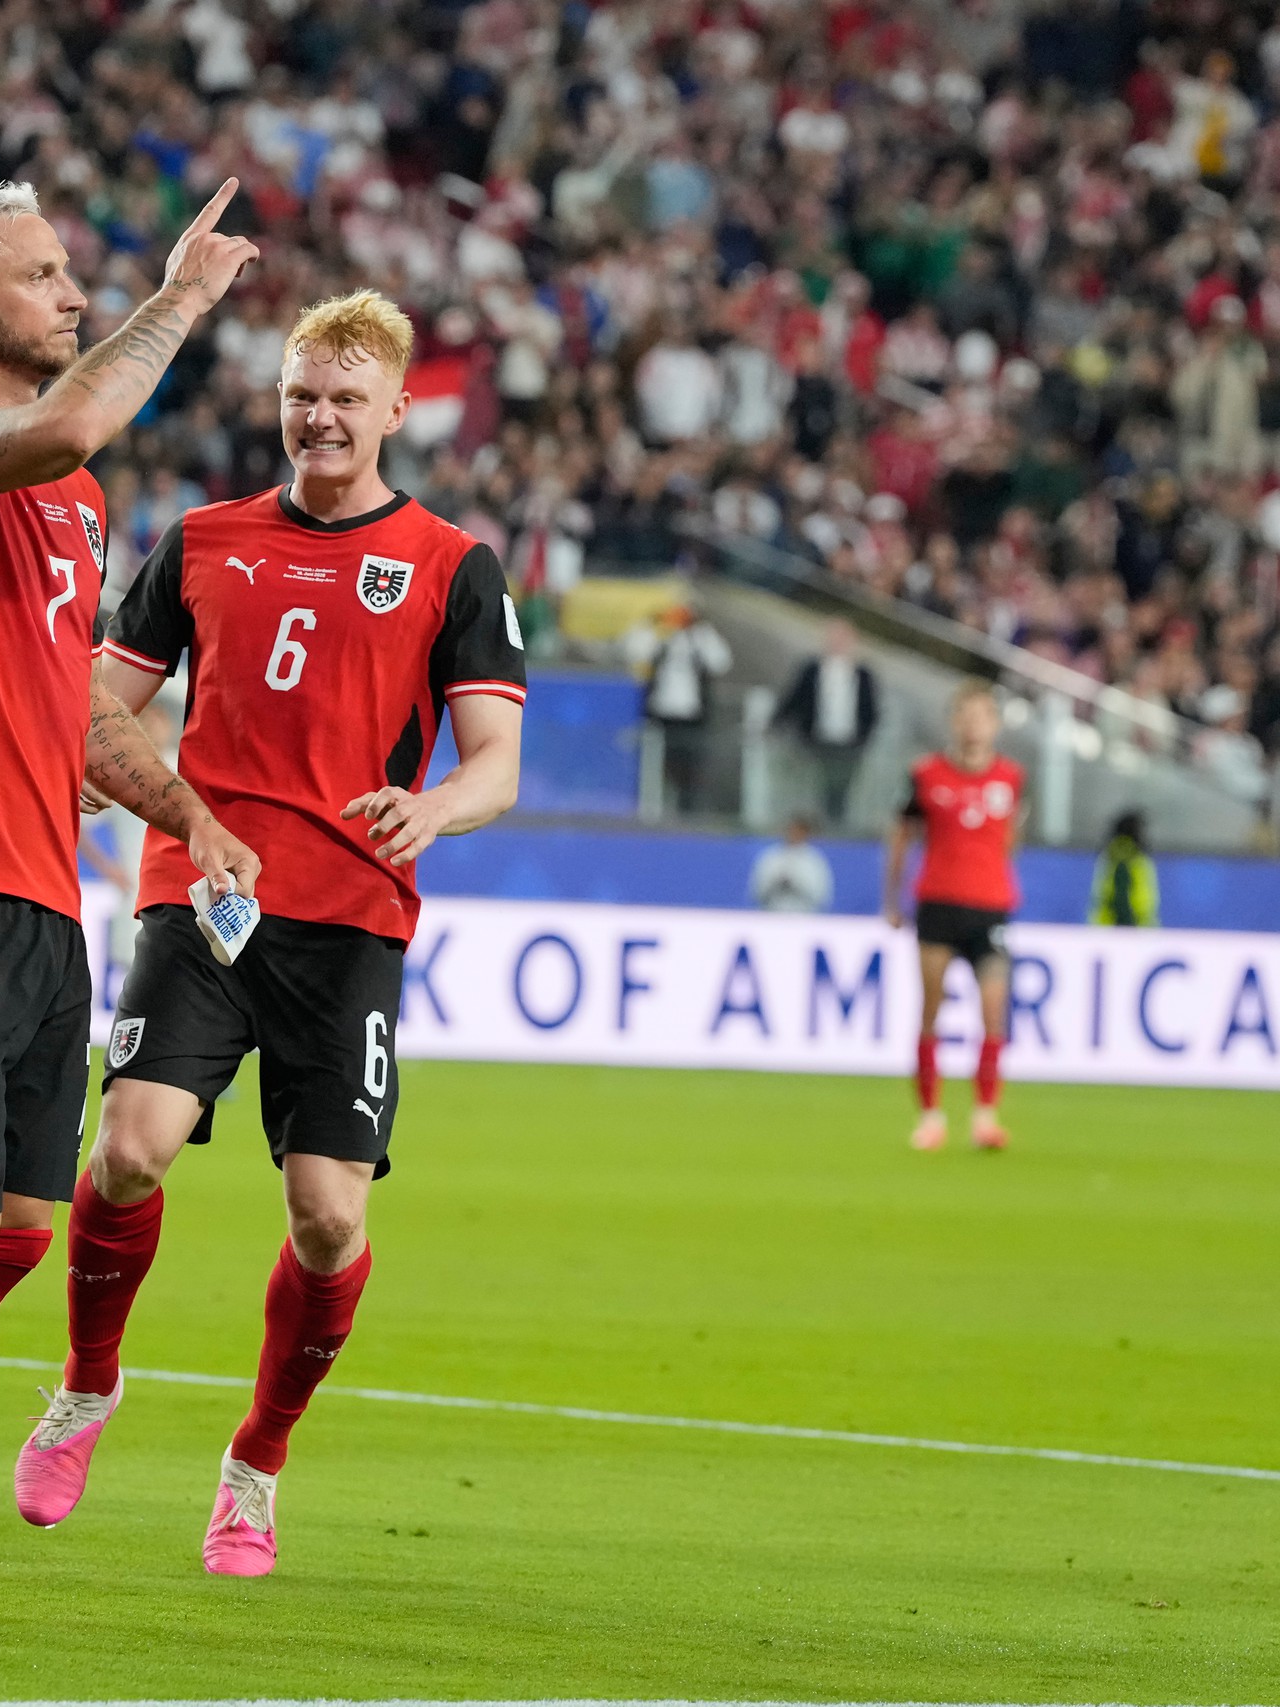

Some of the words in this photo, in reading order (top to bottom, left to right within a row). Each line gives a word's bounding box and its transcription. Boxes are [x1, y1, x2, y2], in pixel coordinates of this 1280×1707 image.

[47, 554, 77, 644] 7
[264, 607, 317, 692] 6
[206, 904, 233, 943] FOOTBALL
[215, 895, 243, 936] UNITES
[512, 932, 661, 1032] OF
[363, 1010, 388, 1099] 6
